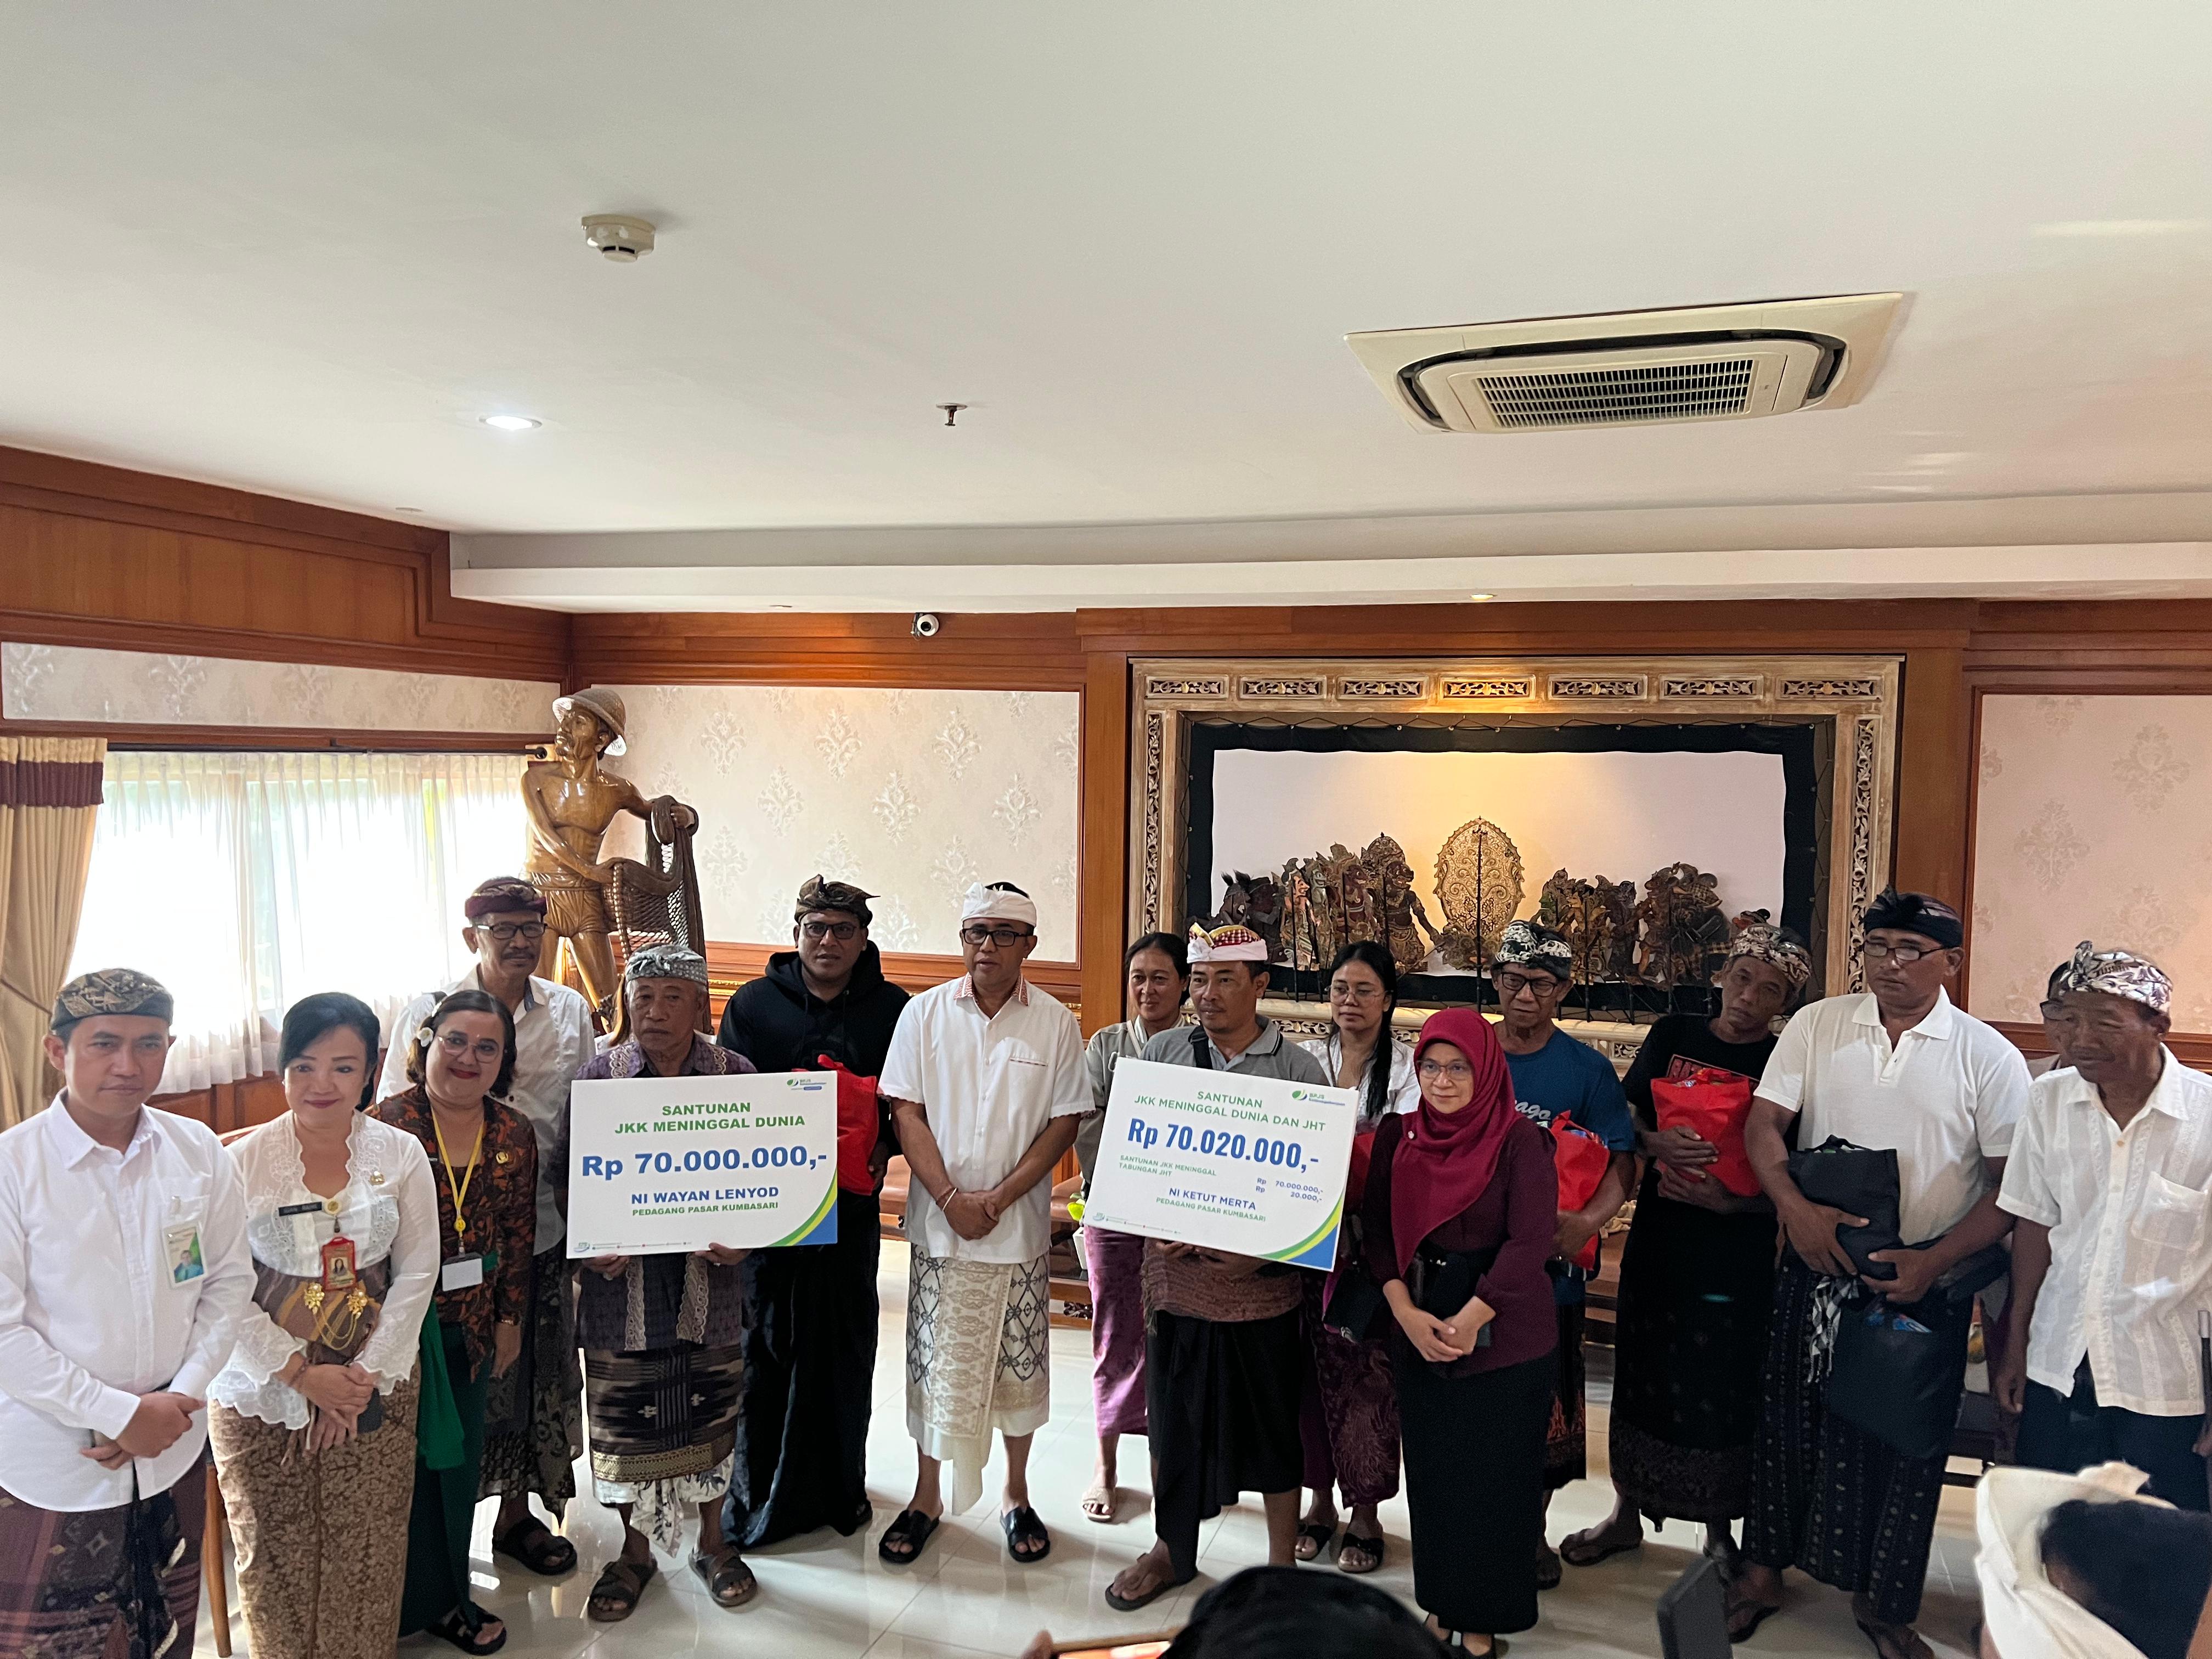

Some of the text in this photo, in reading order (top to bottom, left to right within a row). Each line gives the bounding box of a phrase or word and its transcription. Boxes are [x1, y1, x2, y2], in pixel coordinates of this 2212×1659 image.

[662, 1102, 751, 1116] SANTUNAN
[1197, 1091, 1262, 1108] SANTUNAN
[1135, 1095, 1326, 1131] JKK MENINGGAL DUNIA DAN JHT
[614, 1115, 805, 1134] JKK MENINGGAL DUNIA
[1127, 1118, 1319, 1173] Rp 70.020.000,-
[583, 1146, 827, 1181] Rp 70.000.000,-
[1119, 1163, 1157, 1175] TABUNGAN
[1120, 1155, 1216, 1176] SANTUNAN JKK MENINGGAL
[1257, 1177, 1267, 1186] Rp
[631, 1187, 779, 1204] NI WAYAN LENYOD
[1169, 1187, 1256, 1210] NI KETUT MERTA
[633, 1201, 778, 1216] PEDAGANG PASAR KUMBASARI
[1156, 1197, 1266, 1221] PEDAGANG PASAR KUMBASARI
